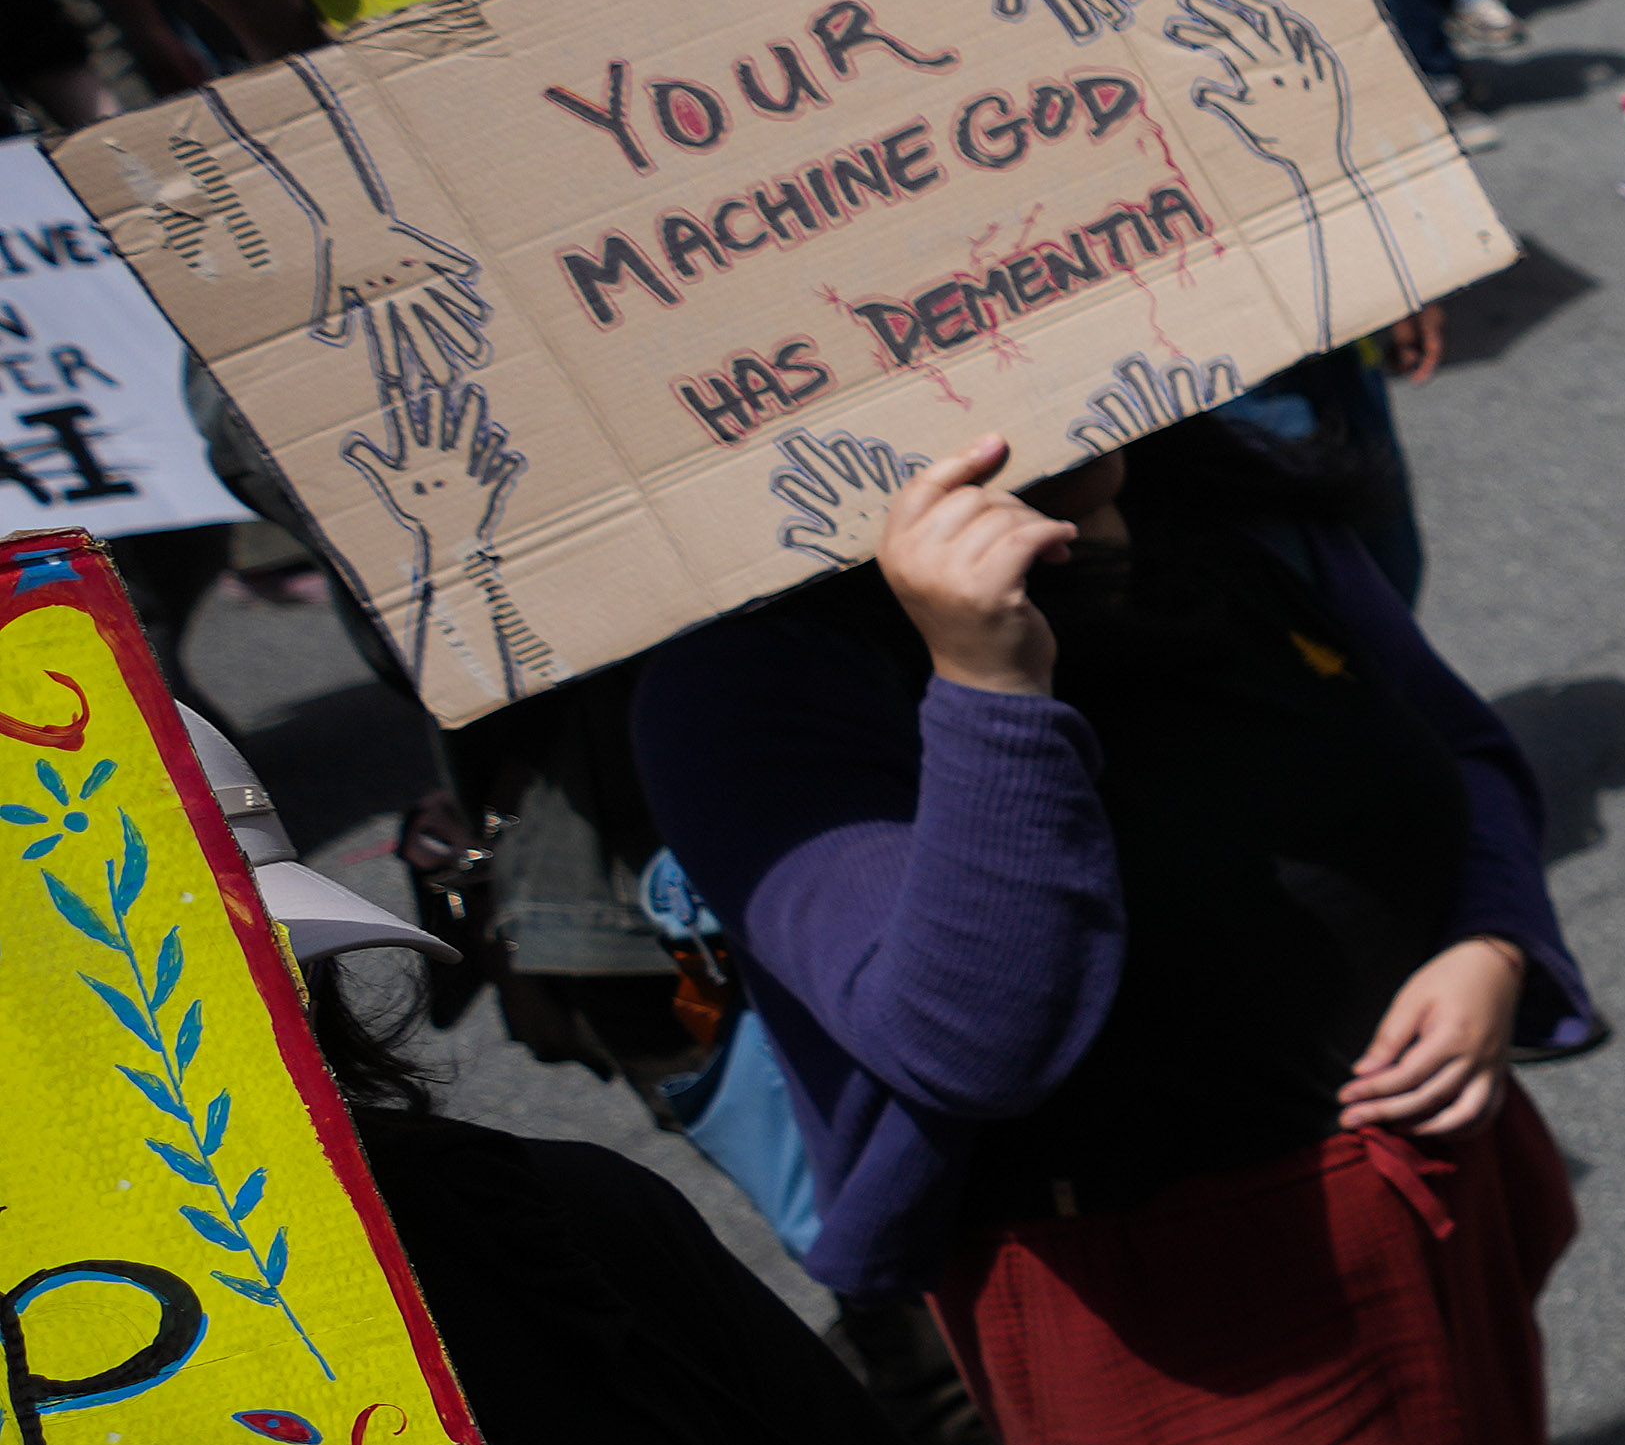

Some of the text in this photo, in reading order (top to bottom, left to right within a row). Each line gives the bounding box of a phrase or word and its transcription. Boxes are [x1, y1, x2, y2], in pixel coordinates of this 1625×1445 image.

[560, 68, 1144, 328] MACHINE GOD
[679, 180, 1208, 447] HAS DEMENTIA
